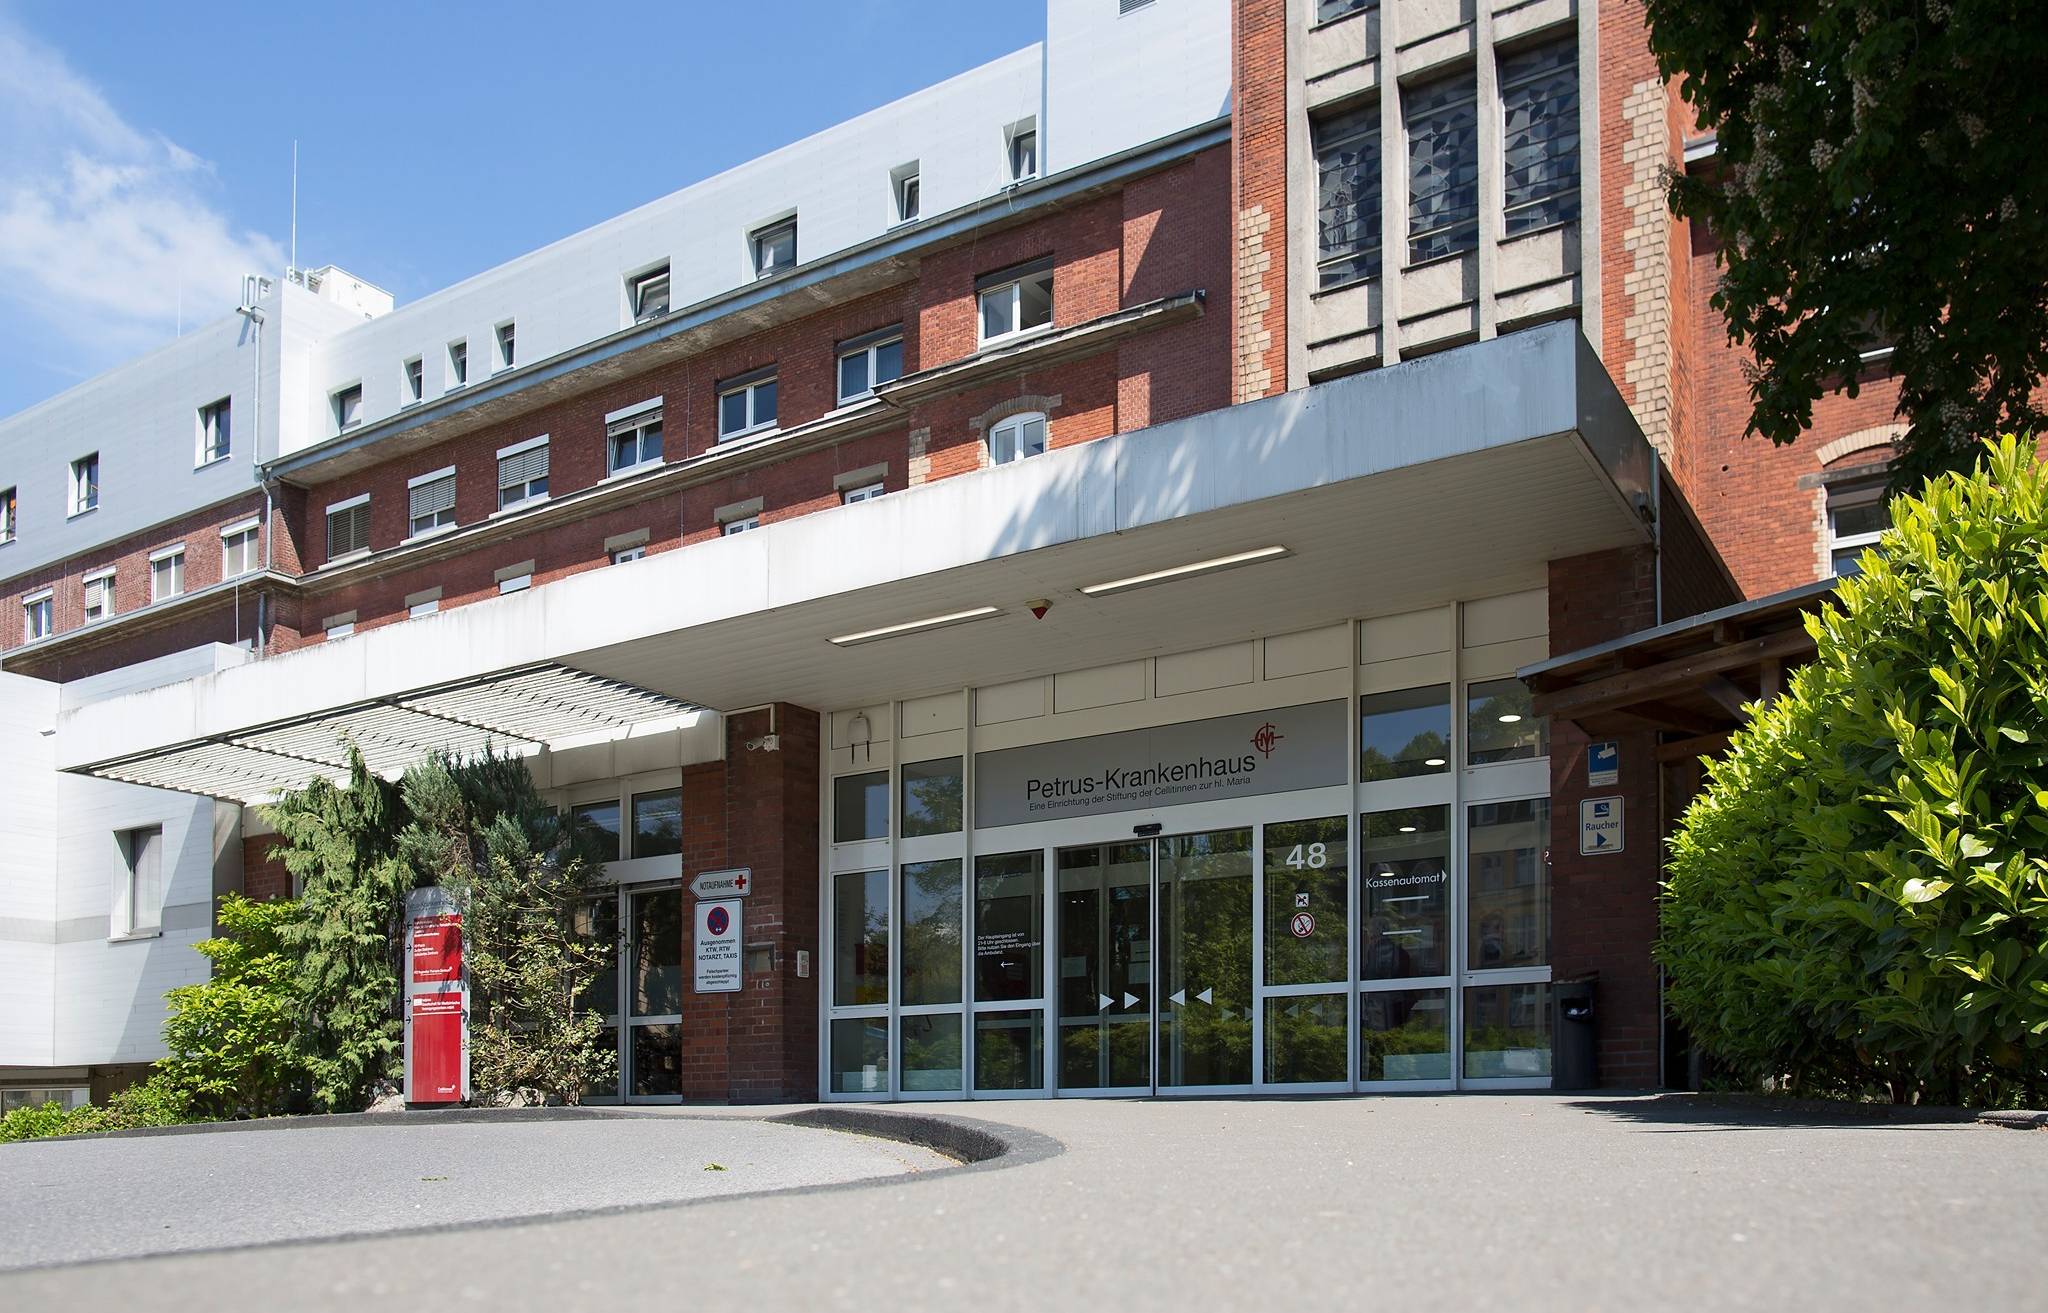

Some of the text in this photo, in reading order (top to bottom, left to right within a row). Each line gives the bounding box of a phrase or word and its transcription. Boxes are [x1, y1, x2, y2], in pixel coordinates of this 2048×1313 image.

[1027, 755, 1256, 800] Petrus-Krankenhaus
[1029, 776, 1251, 811] Eine Einrichtung der Stiftung der Cellitinnen zur hl. Maria
[1585, 821, 1619, 831] Raucher
[1286, 842, 1327, 870] 48
[700, 879, 734, 891] NOTAUFNAHME
[1365, 873, 1441, 889] Kassenautomat
[700, 939, 736, 947] Ausgenommen
